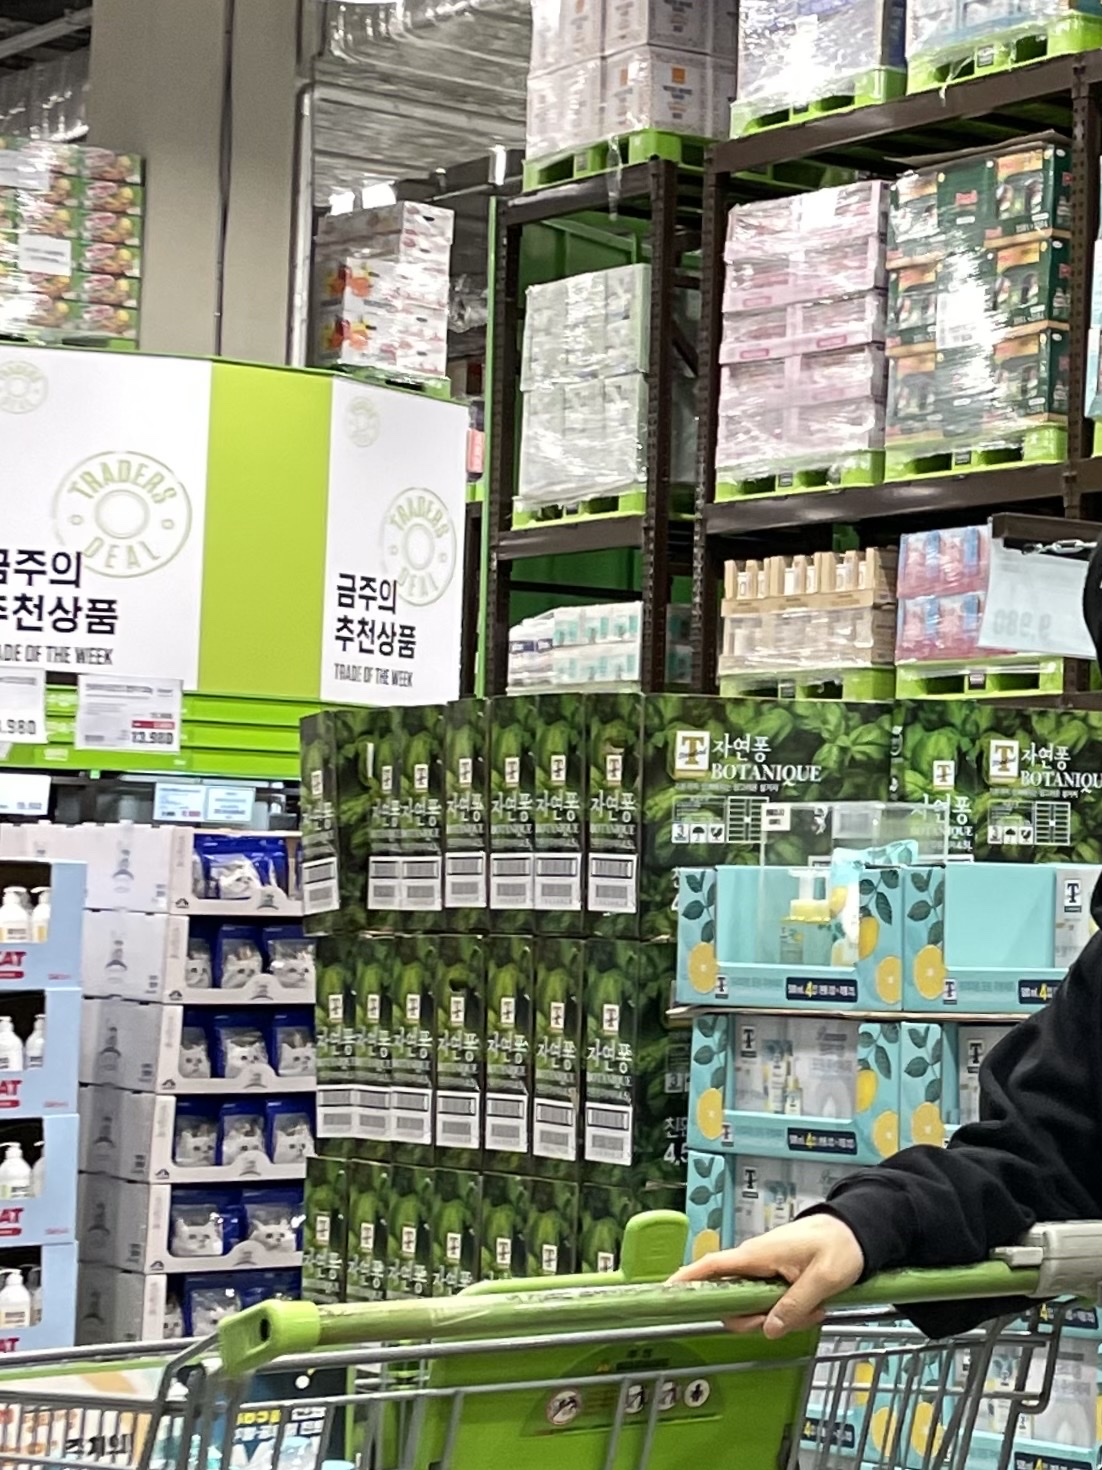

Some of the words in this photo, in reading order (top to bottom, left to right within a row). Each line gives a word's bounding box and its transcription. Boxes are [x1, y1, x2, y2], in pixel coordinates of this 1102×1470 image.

[71, 460, 177, 505] TRADERS
[390, 494, 447, 540] TRADERS
[0, 549, 82, 588] 주의
[83, 535, 161, 570] DEAL
[337, 573, 398, 614] 금주의
[0, 597, 118, 635] 천상품
[335, 614, 416, 659] 추천상품
[25, 645, 41, 663] OF
[47, 646, 71, 664] THE
[75, 647, 113, 665] WEEK
[334, 663, 361, 682] TRADE
[363, 667, 374, 684] OF
[376, 668, 391, 686] THE
[392, 669, 413, 688] WEEK
[0, 719, 36, 735] ,980
[682, 736, 704, 765] T
[711, 733, 772, 762] 자연퐁
[995, 745, 1014, 772] T
[1021, 743, 1071, 770] 자연퐁
[711, 763, 821, 786] BOTANIQUE
[491, 791, 533, 822] 자연퐁
[536, 789, 580, 822] 자연퐁
[590, 789, 636, 823] 자연퐁
[0, 951, 27, 966] AT
[487, 1031, 529, 1064] 자연퐁
[537, 1035, 577, 1071] 자연퐁
[587, 1038, 633, 1074] 자연퐁
